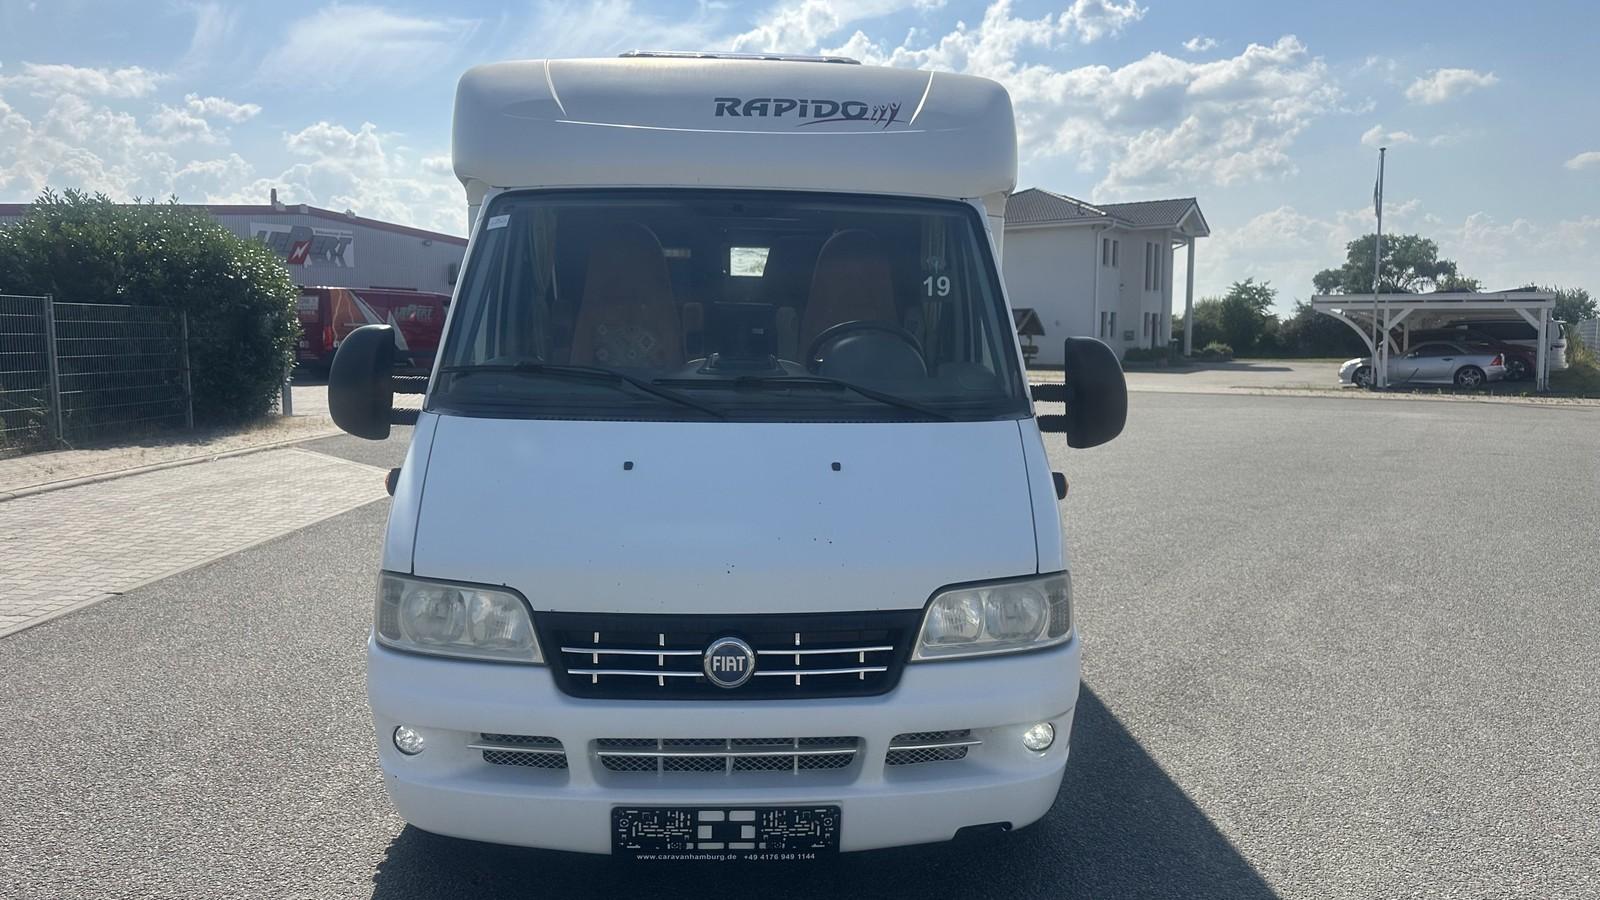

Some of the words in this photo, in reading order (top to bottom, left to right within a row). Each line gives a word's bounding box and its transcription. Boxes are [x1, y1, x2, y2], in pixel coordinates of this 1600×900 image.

[923, 275, 951, 297] 19
[712, 655, 746, 672] FIAT
[636, 853, 737, 861] www.caravanhamburg.de
